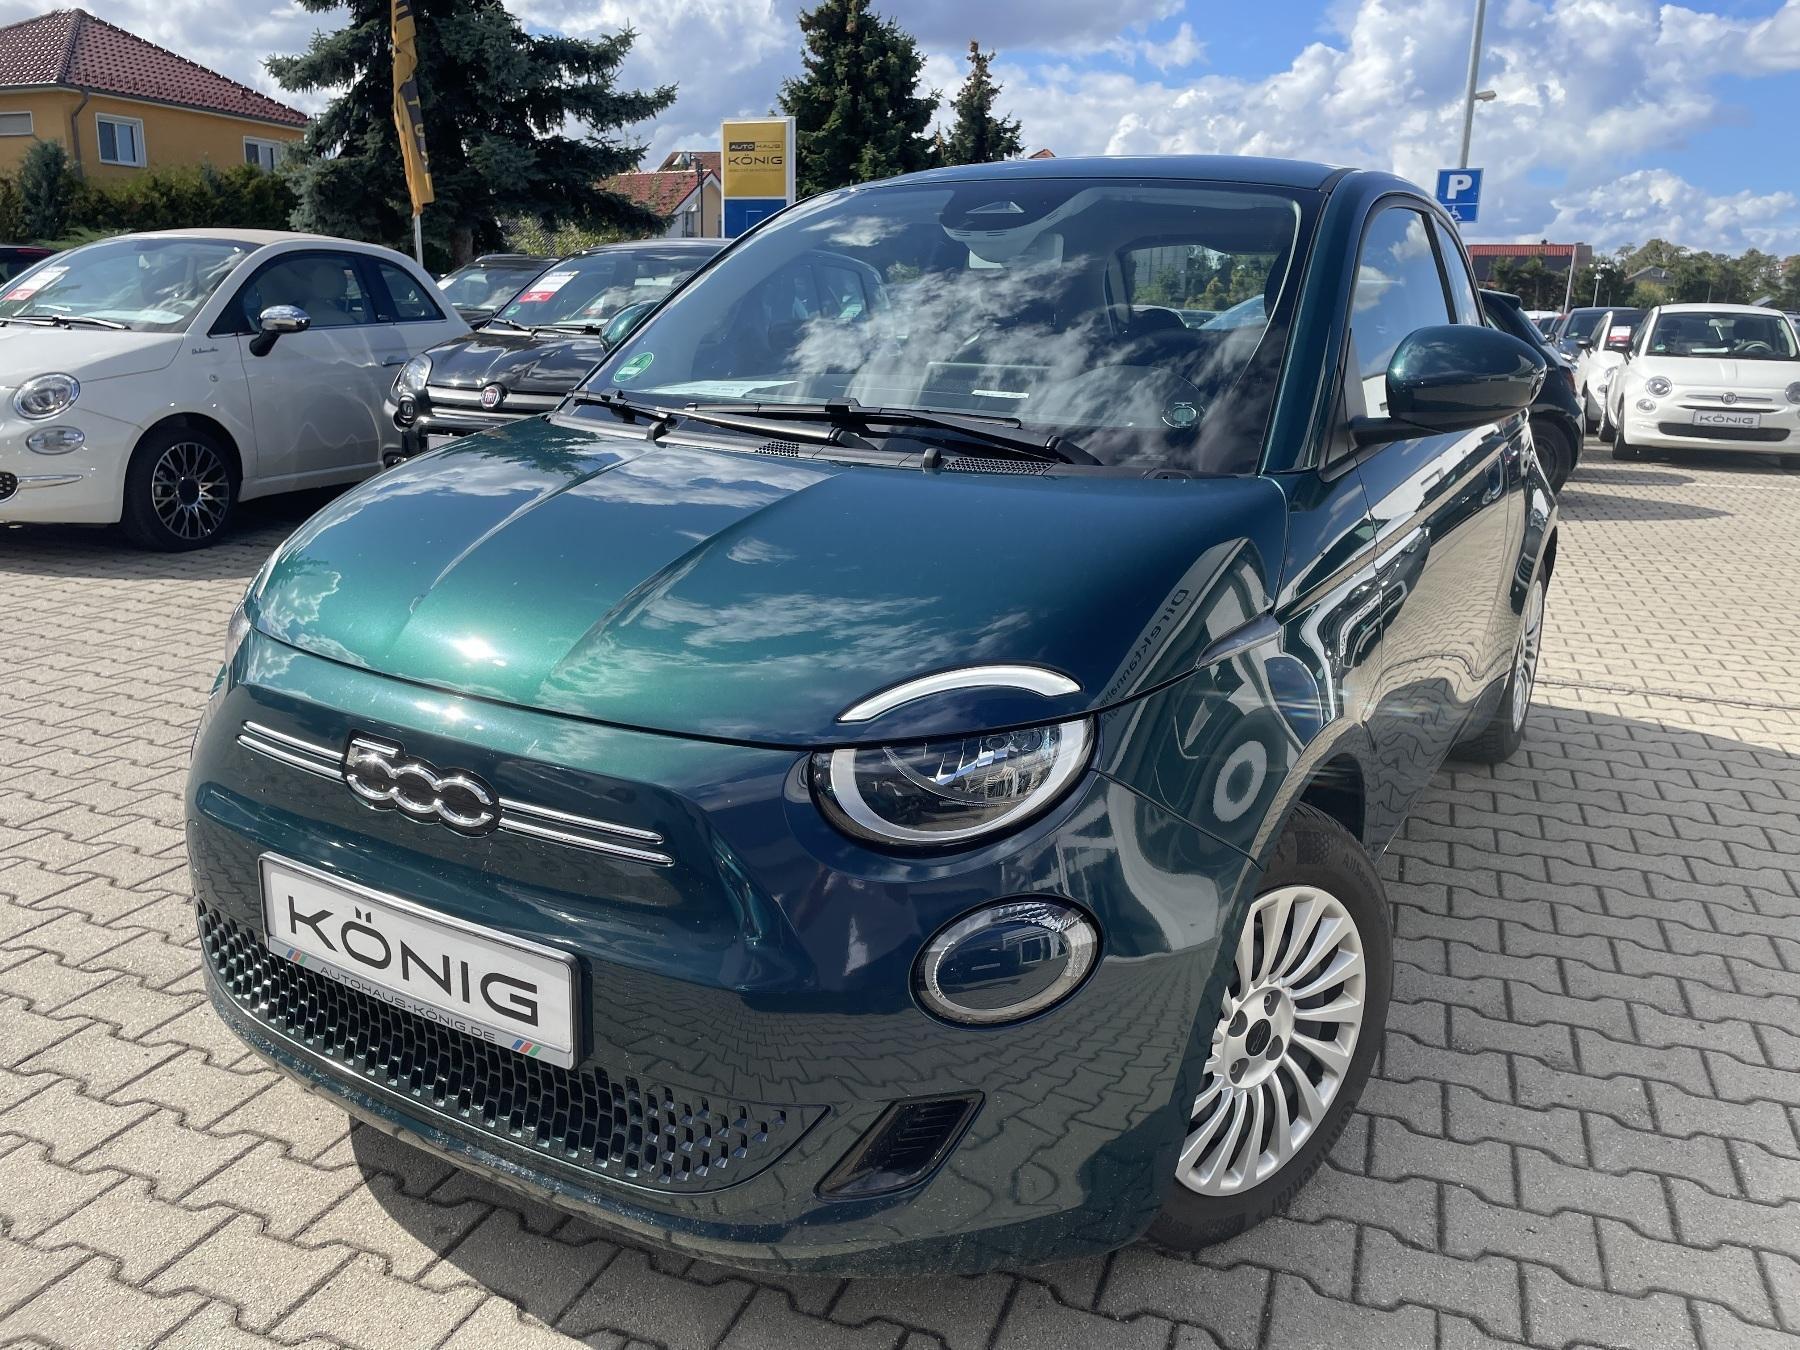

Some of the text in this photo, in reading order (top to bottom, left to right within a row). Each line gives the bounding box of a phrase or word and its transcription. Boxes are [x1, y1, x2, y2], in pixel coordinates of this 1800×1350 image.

[728, 154, 783, 165] KÖNIG
[1447, 174, 1473, 200] P
[1699, 413, 1755, 425] KÖNIG
[346, 737, 495, 828] 500
[287, 895, 539, 1028] KÖNIG
[320, 966, 496, 1042] AUTOHAUS-KÖNIG.DE
